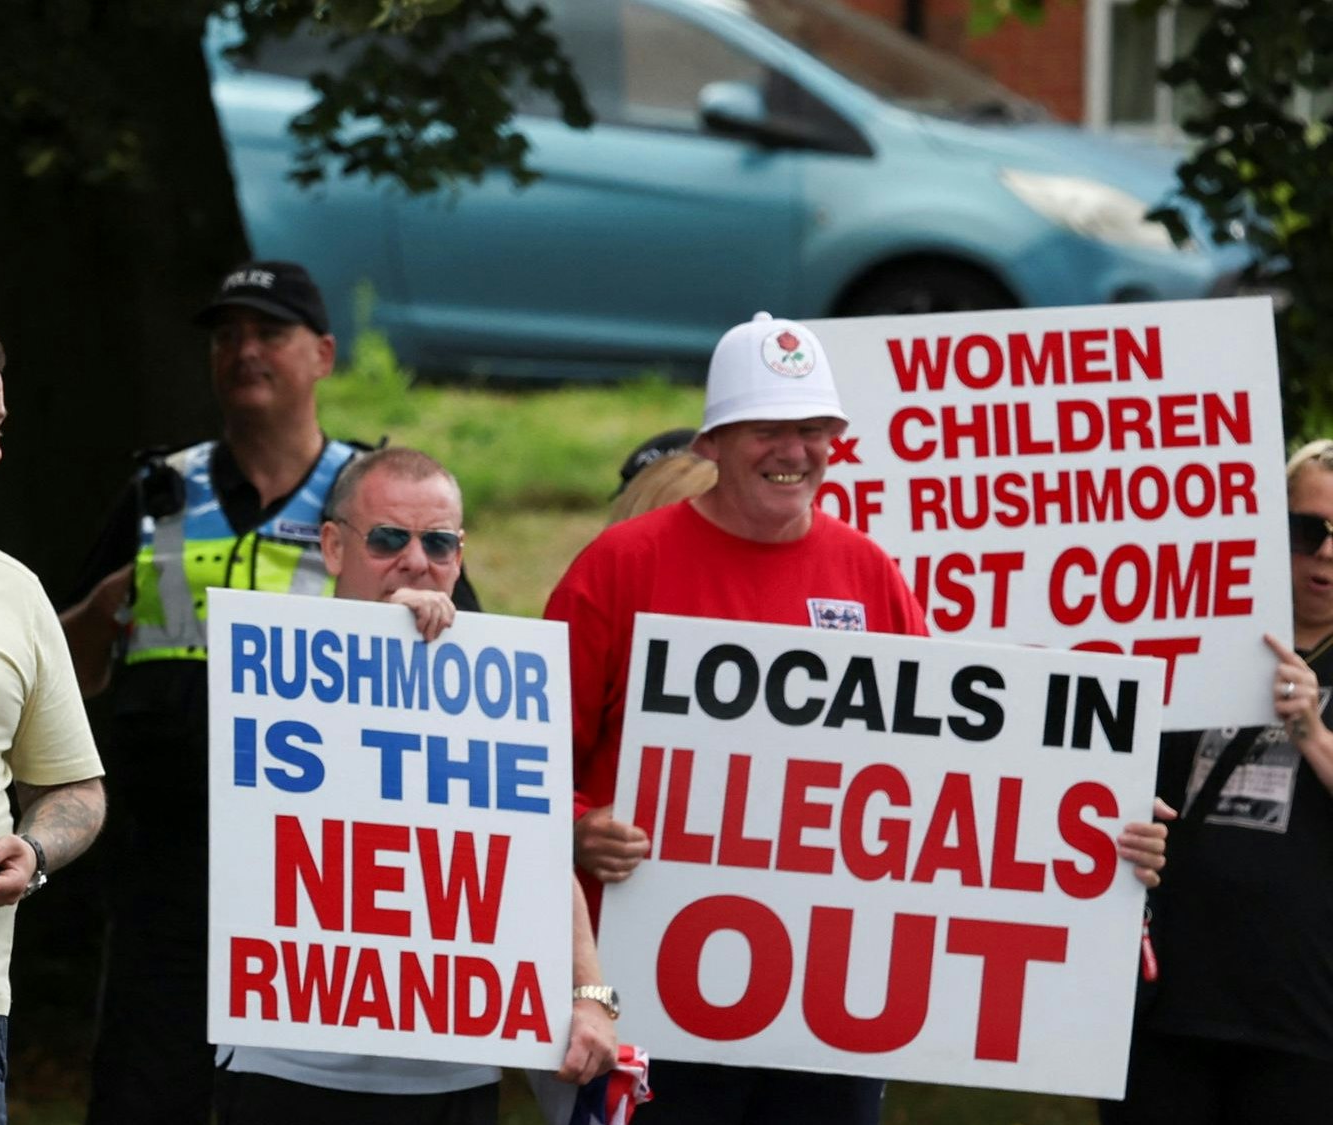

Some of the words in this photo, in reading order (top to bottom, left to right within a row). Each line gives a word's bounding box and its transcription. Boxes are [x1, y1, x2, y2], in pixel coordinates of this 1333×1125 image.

[887, 327, 1163, 392] WOMEN
[889, 391, 1251, 462] CHILDREN
[909, 462, 1258, 531] RUSHMOOR
[1049, 539, 1256, 626] COME
[231, 623, 549, 722] RUSHMOOR
[641, 639, 1006, 742] LOCALS
[1042, 673, 1139, 754] IN
[233, 717, 325, 793] IS
[361, 729, 550, 814] THE
[633, 746, 1120, 899] ILLEGALS
[275, 815, 510, 944] NEW
[230, 937, 552, 1043] RWANDA
[656, 895, 1068, 1063] OUT
